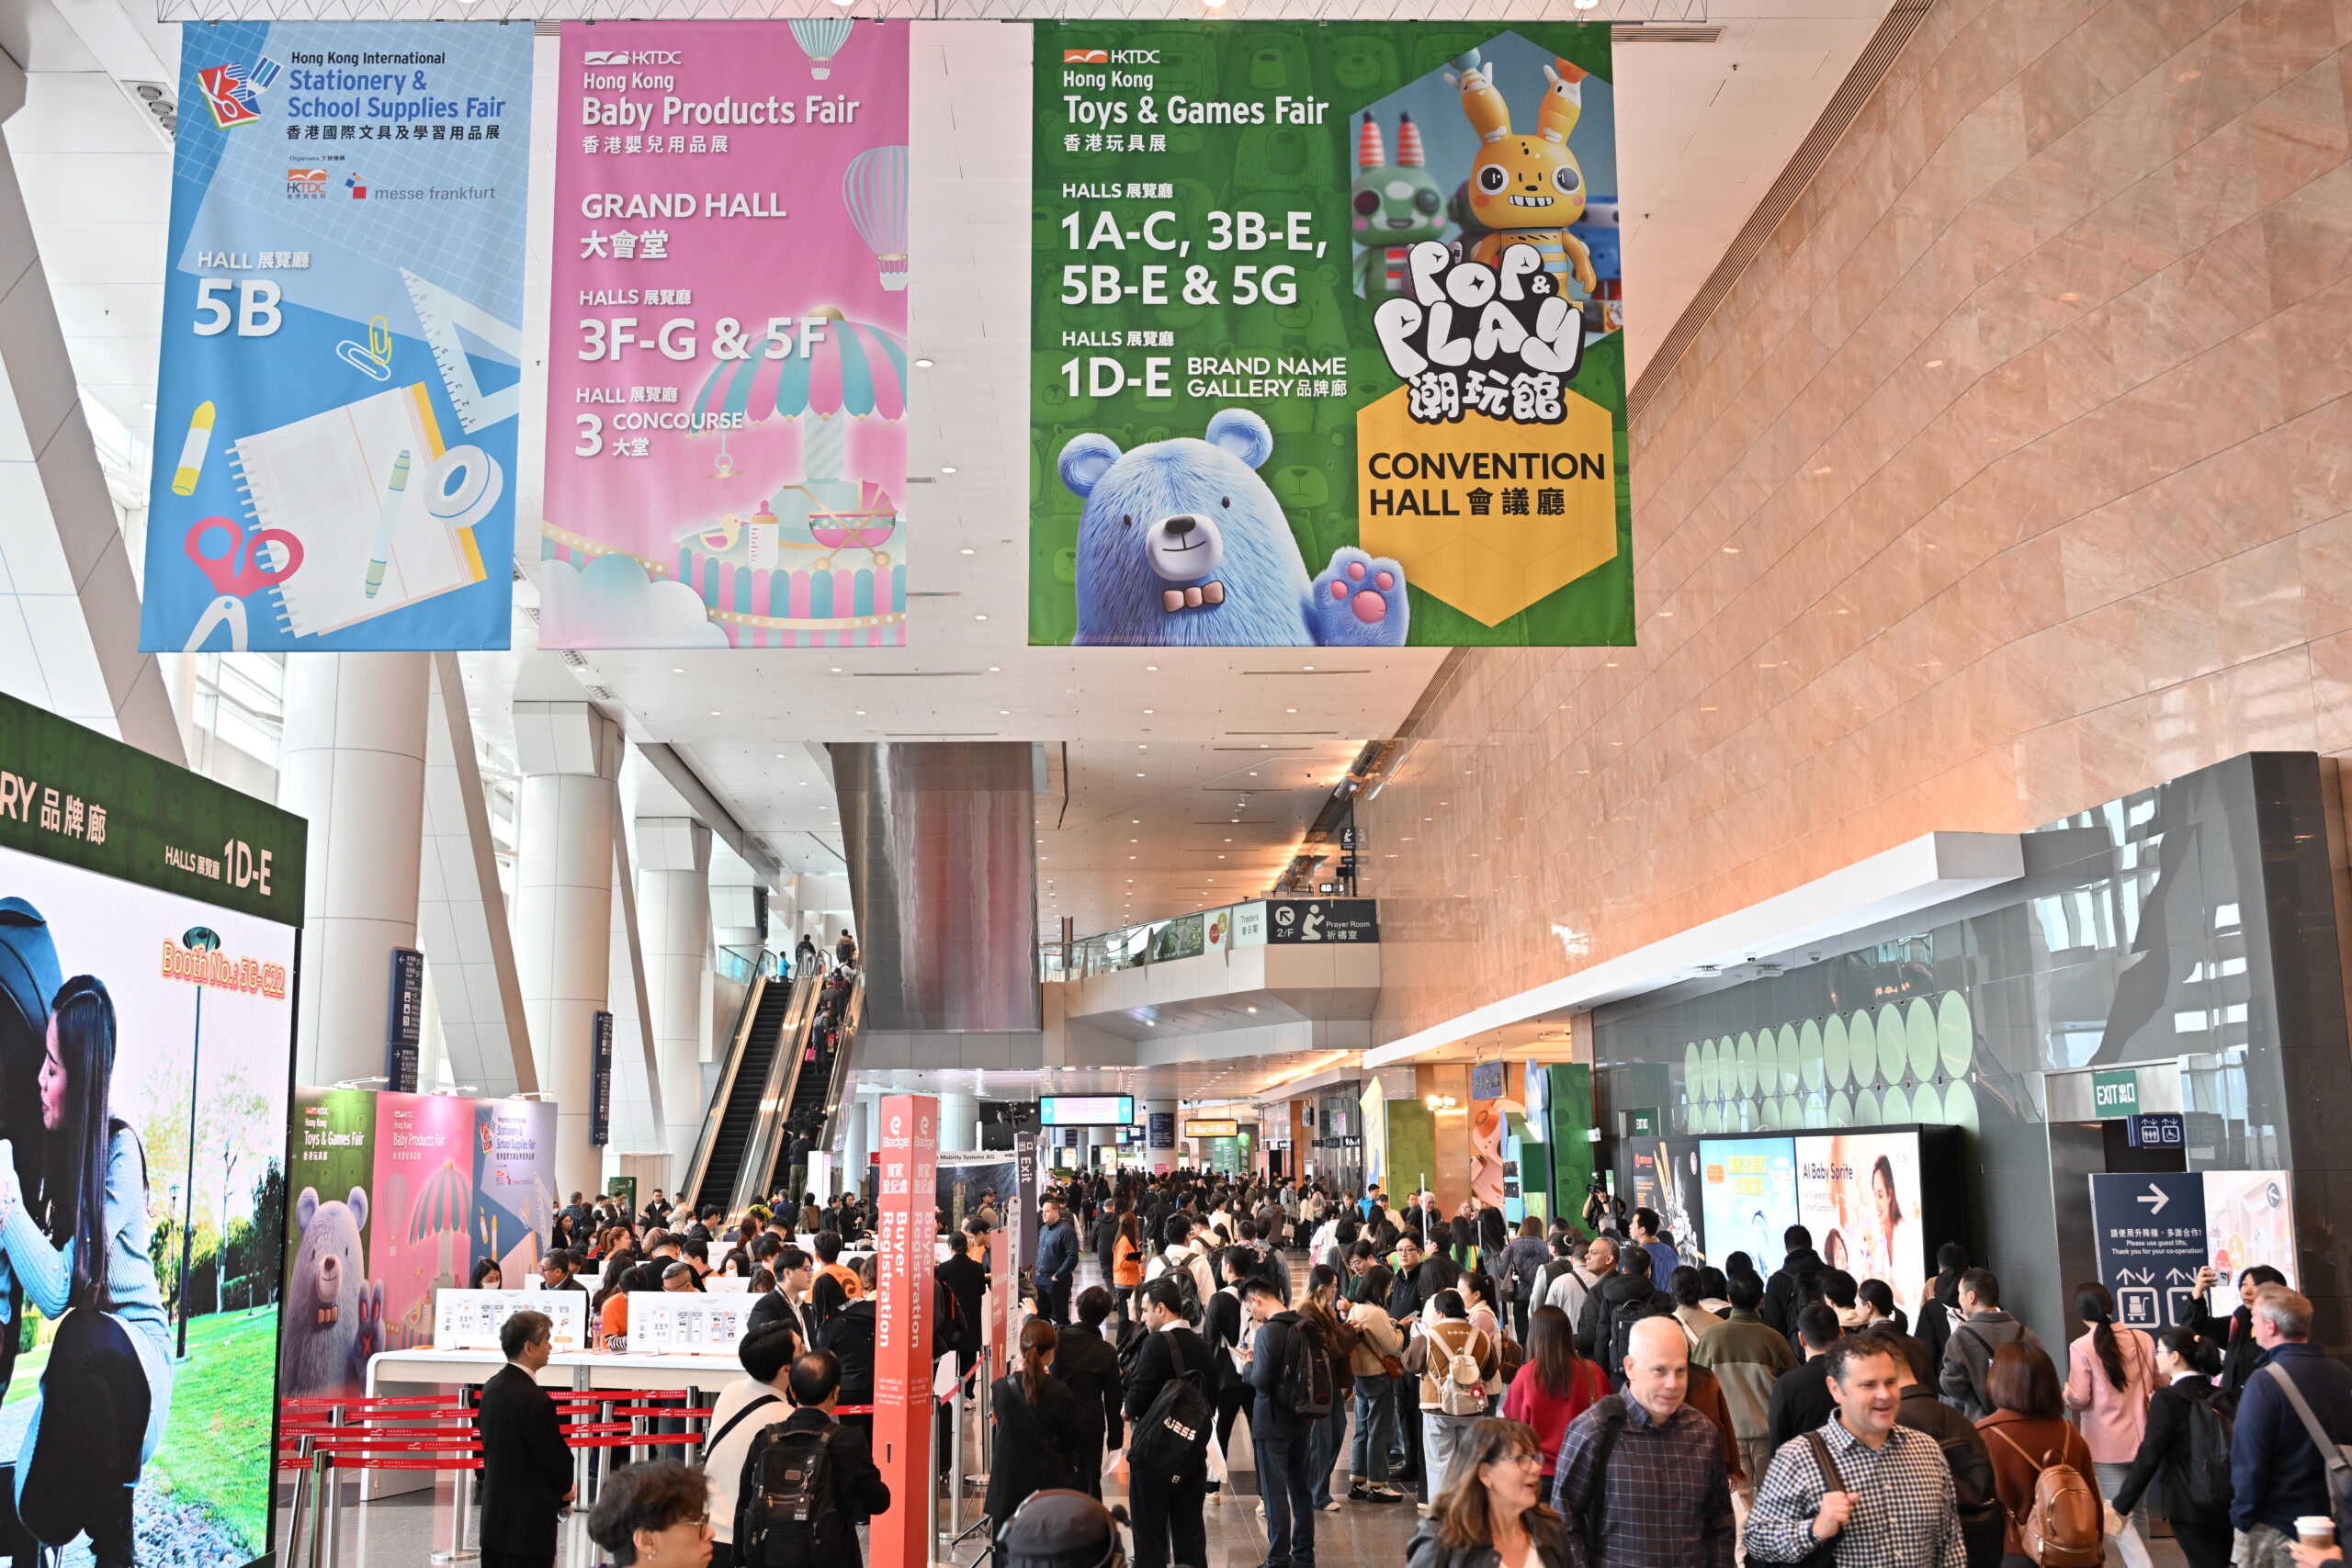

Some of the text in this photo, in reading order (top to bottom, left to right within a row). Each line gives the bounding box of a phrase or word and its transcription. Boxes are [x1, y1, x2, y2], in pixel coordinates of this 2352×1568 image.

[291, 51, 446, 66] Hong Kong International
[631, 51, 682, 65] HKTDC
[1111, 51, 1160, 64] HKTDC
[289, 70, 427, 94] Stationery &
[583, 73, 674, 92] Hong Kong
[1063, 72, 1154, 90] Hong Kong
[288, 97, 506, 122] School Supplies Fair
[582, 95, 860, 130] Baby Products Fair
[1064, 96, 1329, 130] Toys & Games Fair
[287, 125, 501, 141] 香港國際文具及學習用品展
[1063, 134, 1167, 152] 香港玩具展
[582, 135, 729, 154] 香港嬰兒用品展
[287, 182, 327, 194] HKTDC
[375, 186, 496, 200] messe frankfurt
[1062, 183, 1173, 198] HALLS 展覽廳
[581, 193, 787, 220] GRAND HALL
[580, 230, 669, 260] 大會堂
[1061, 211, 1328, 259] 1A-C, 3B-E,
[198, 251, 310, 270] HALL 展覽廳
[1409, 241, 1551, 308] POP &
[1061, 265, 1297, 306] 5B-E & 5G
[193, 277, 283, 337] 5B
[579, 289, 692, 306] HALLS 展覽廳
[578, 317, 828, 362] 3F-G & 5F
[1062, 331, 1174, 346] HALLS 展覽廳
[1374, 296, 1582, 378] PLAY
[1187, 357, 1347, 376] BRAND NAME
[1061, 356, 1172, 398] 1D-E
[576, 387, 678, 404] HALL 展覽廳
[1187, 379, 1348, 398] GALLERY 品牌廊
[1409, 369, 1563, 421] 潮玩館
[612, 412, 743, 430] CONCOURSE
[575, 413, 604, 457] 3
[612, 438, 650, 457] 大堂
[1368, 452, 1605, 479] CONVENTION
[1370, 487, 1566, 516] HALL 會議廳
[40, 787, 107, 845] 品牌廊
[165, 845, 196, 873] HALLS
[224, 838, 272, 897] 1D-E
[1277, 929, 1295, 938] 2/F
[162, 941, 286, 999] Booth No.: 5G-C22
[2097, 1085, 2118, 1105] EXIT
[304, 1131, 365, 1148] Toys & Games Fair
[393, 1134, 446, 1148] Baby Products Fair
[883, 1137, 910, 1149] Badge
[914, 1137, 935, 1149] Badge
[887, 1163, 903, 1178] 買家
[1020, 1156, 1033, 1183] Exit
[1804, 1164, 1811, 1179] AI
[1812, 1163, 1829, 1183] Baby
[1831, 1163, 1852, 1183] Sprite
[893, 1212, 908, 1277] Buyer
[922, 1212, 933, 1276] Buyer
[879, 1212, 894, 1348] Registration
[911, 1212, 922, 1348] Registration
